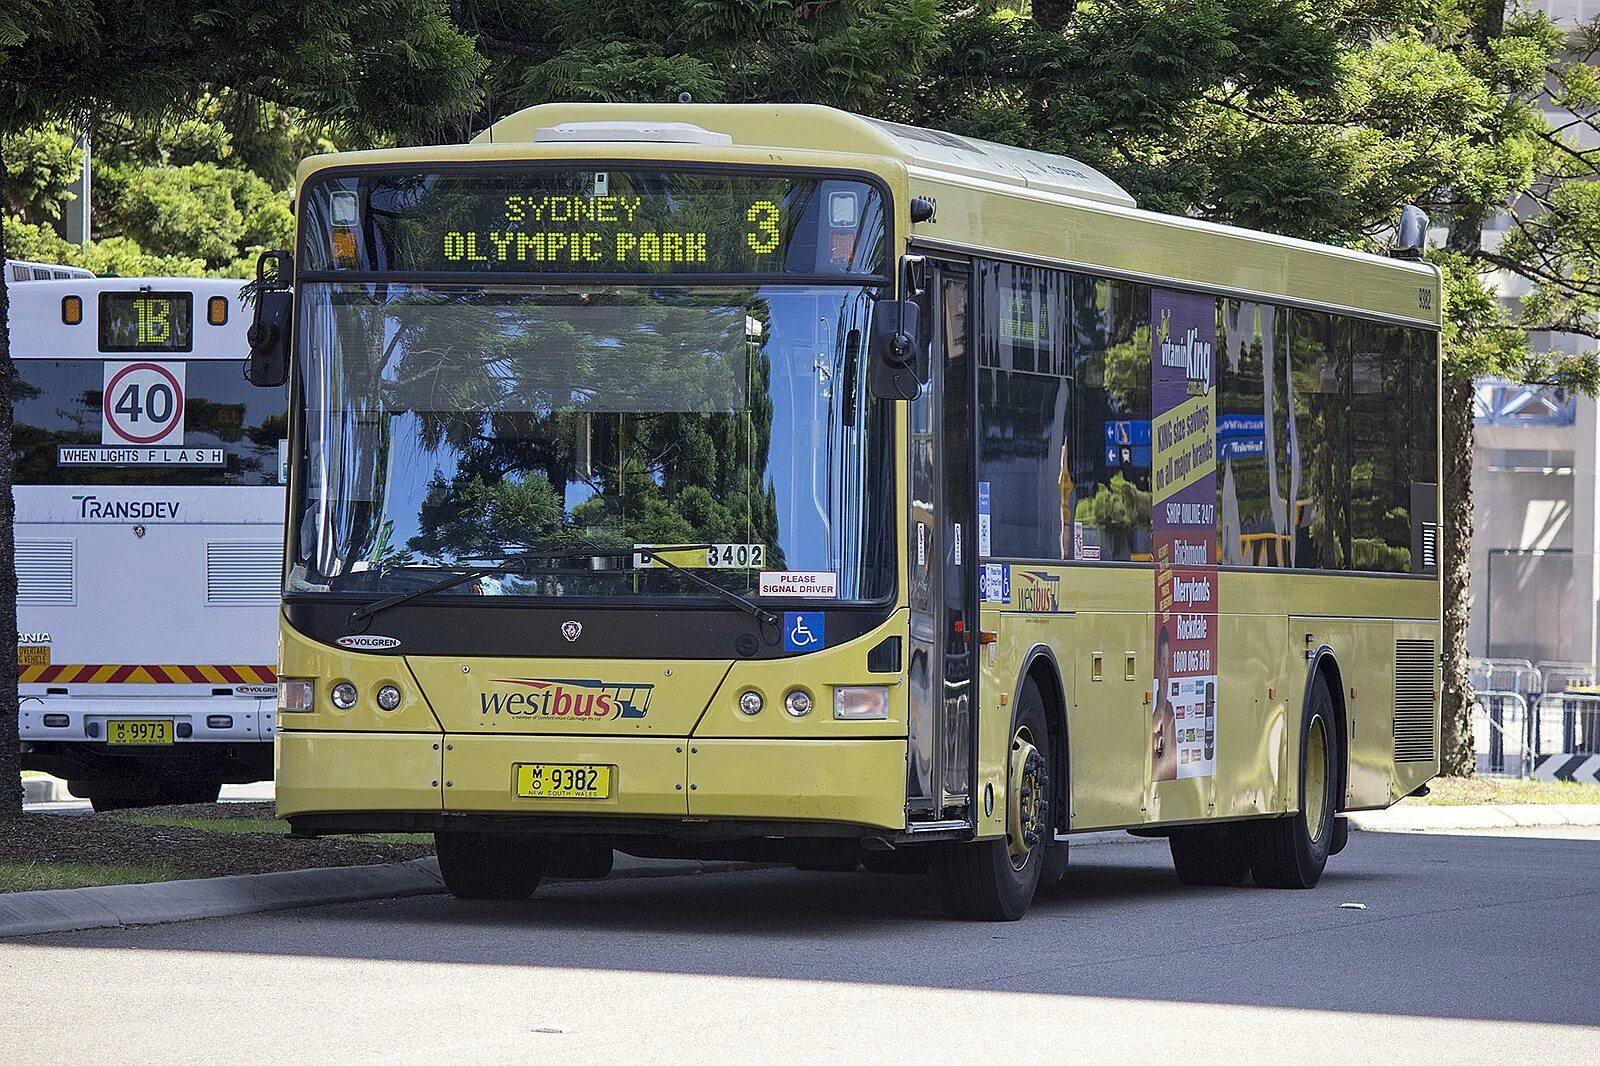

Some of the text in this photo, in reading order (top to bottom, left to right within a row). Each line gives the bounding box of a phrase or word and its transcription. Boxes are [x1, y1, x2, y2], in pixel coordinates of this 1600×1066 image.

[505, 196, 641, 221] SYDNEY
[747, 200, 780, 254] 3
[444, 231, 707, 262] OLYMPIC PARK
[133, 298, 170, 343] 1B
[115, 383, 174, 423] 40
[1157, 420, 1172, 453] KING
[1173, 416, 1185, 444] size
[1187, 405, 1210, 437] savings
[63, 450, 97, 462] WHEN
[100, 450, 139, 462] LIGHTS
[1156, 434, 1213, 491] on all major brands
[1166, 502, 1214, 525] SHOP ONLINE 24/7
[708, 545, 762, 566] 3402
[763, 585, 797, 593] SIGNAL
[780, 575, 816, 583] PLEASE
[1173, 575, 1211, 608] Merrylands
[1017, 579, 1050, 611] westbus
[18, 632, 52, 643] ANIA
[1177, 614, 1207, 640] Rockdale
[354, 638, 397, 647] VOLGREN
[1173, 650, 1187, 672] 1800
[480, 686, 611, 717] westbus
[131, 723, 164, 739] 9973
[551, 769, 598, 790] 9382
